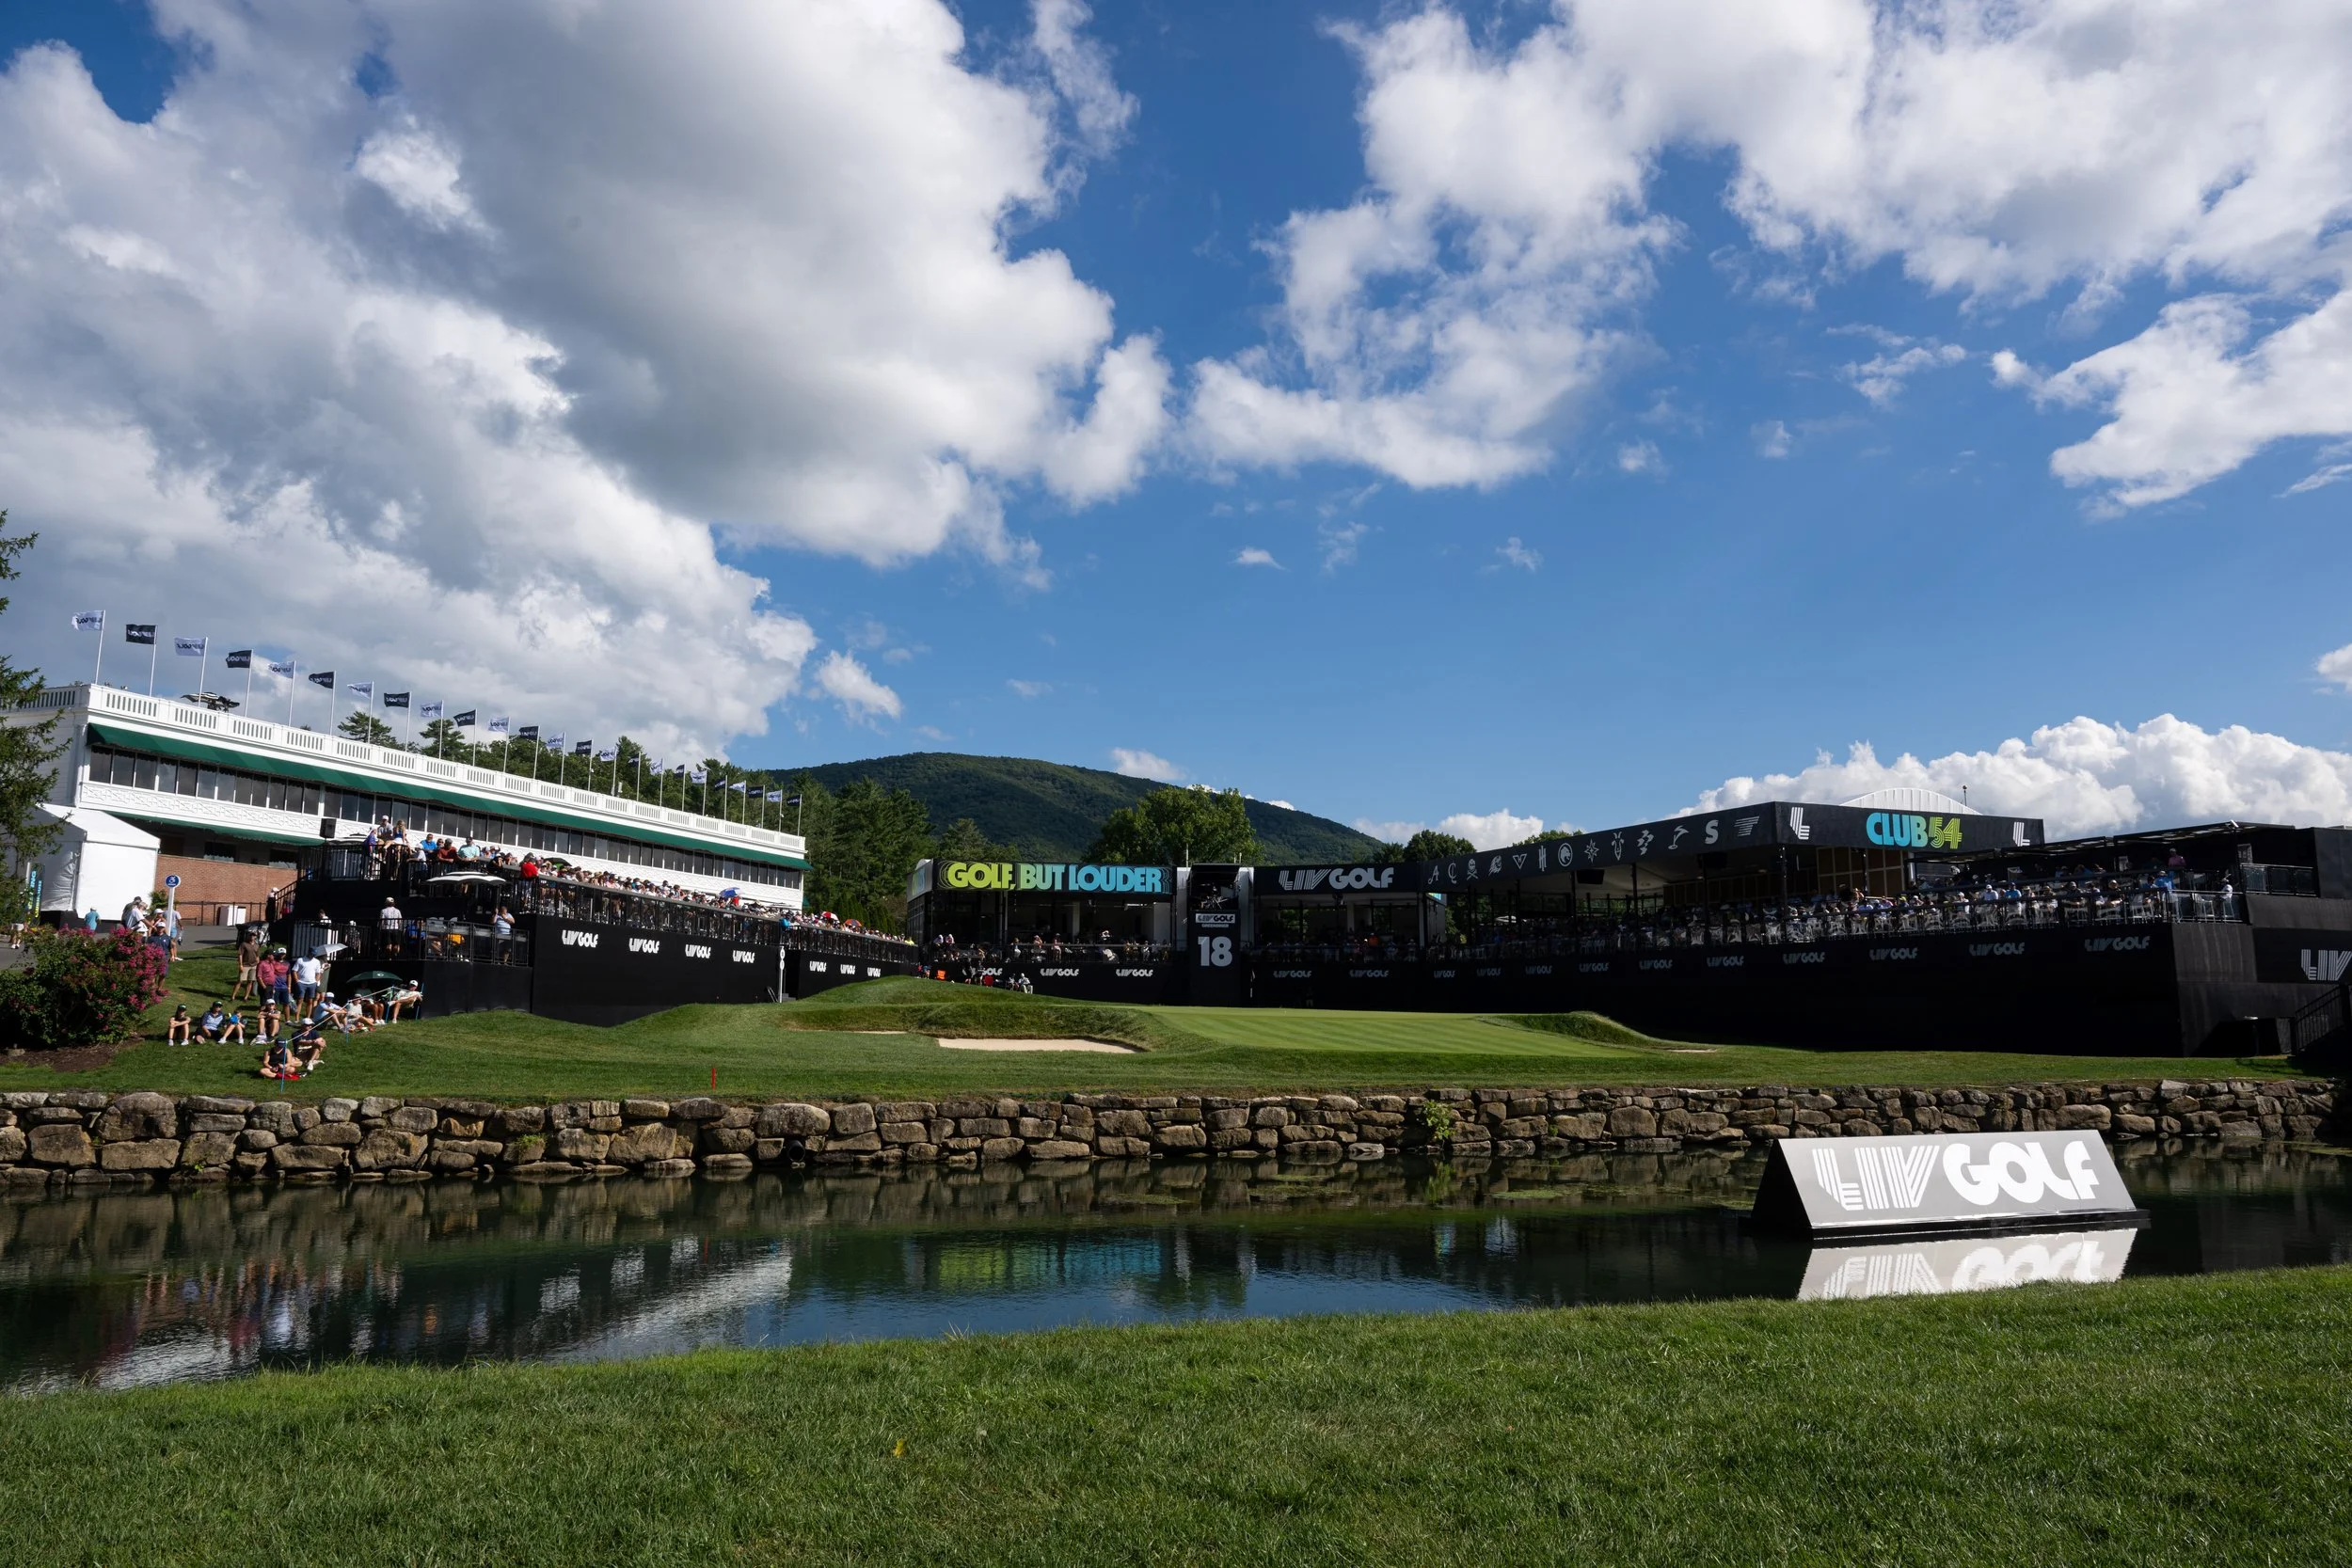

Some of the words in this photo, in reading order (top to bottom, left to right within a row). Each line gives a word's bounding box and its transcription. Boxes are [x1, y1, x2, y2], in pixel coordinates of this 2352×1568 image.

[1866, 812, 1929, 847] CLUB
[1929, 816, 1963, 849] 54
[1021, 863, 1066, 891] BUT
[1069, 864, 1163, 893] LOUDER
[1278, 869, 1332, 892] LIV
[1328, 867, 1395, 890] GOLF
[1214, 914, 1234, 923] GOLF
[562, 929, 580, 946] LIV
[578, 931, 599, 948] GOLF
[629, 938, 644, 952] LIV
[642, 940, 660, 954] GOLF
[2084, 938, 2115, 953] LIV
[2112, 936, 2151, 951] GOLF
[685, 943, 698, 958] LIV
[696, 945, 711, 959] GOLF
[733, 950, 743, 962] LIV
[742, 951, 755, 964] GOLF
[1198, 936, 1233, 967] 18
[1869, 948, 1892, 960] LIV
[1890, 946, 1919, 960] GOLF
[1969, 942, 1994, 958] LIV
[1994, 942, 2026, 957] GOLF
[1639, 958, 1656, 971] LIV
[1653, 958, 1674, 971] GOLF
[1706, 955, 1725, 968] LIV
[1723, 955, 1745, 968] GOLF
[1783, 952, 1802, 965] LIV
[1799, 951, 1826, 964] GOLF
[2300, 949, 2352, 982] LIV
[1040, 968, 1058, 976] LIV
[1057, 968, 1080, 976] GOLF
[1115, 969, 1134, 977] LIV
[1132, 969, 1154, 977] GOLF
[1273, 970, 1291, 978] LIV
[1289, 970, 1313, 978] GOLF
[1349, 969, 1367, 978] LIV
[1365, 969, 1391, 978] GOLF
[1579, 962, 1593, 973] LIV
[1591, 962, 1610, 973] GOLF
[1812, 1145, 1941, 1212] LIV
[1943, 1140, 2101, 1207] GOLF
